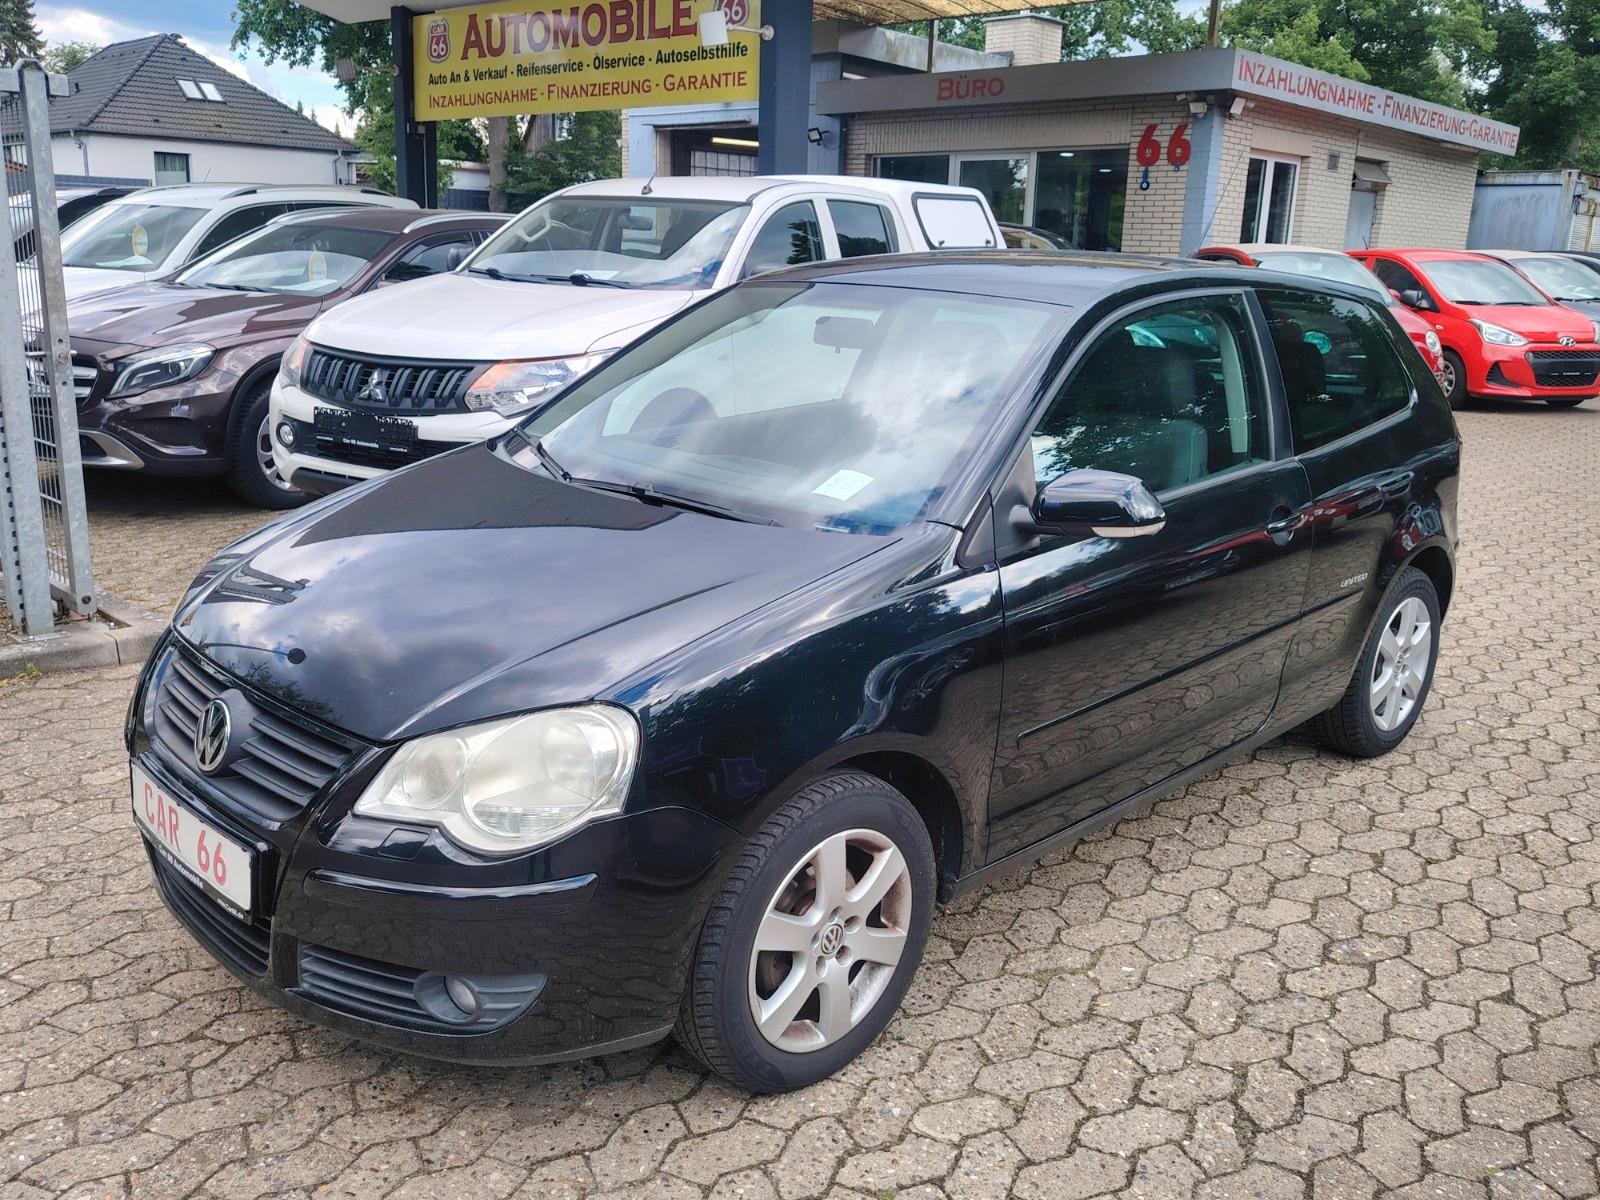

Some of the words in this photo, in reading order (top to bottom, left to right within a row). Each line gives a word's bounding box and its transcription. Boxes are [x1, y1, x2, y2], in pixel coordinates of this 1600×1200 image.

[431, 37, 446, 57] 66
[460, 0, 697, 60] AUTOMOBILE
[428, 73, 448, 86] Auto
[450, 70, 461, 83] An
[463, 69, 470, 82] &
[473, 65, 508, 82] Verkauf
[516, 60, 584, 77] Reifenservice
[593, 52, 645, 70] Ölservice
[655, 42, 748, 65] Autoselbsthilfe
[1238, 55, 1376, 113] INZAHLUNGNAHME
[428, 88, 538, 109] INZAHLUNGNAHME
[547, 78, 651, 100] FINANZIERUNG
[663, 71, 748, 92] GARANTIE
[936, 75, 1005, 101] BÜRO
[143, 782, 181, 853] CAR
[197, 829, 227, 886] 66
